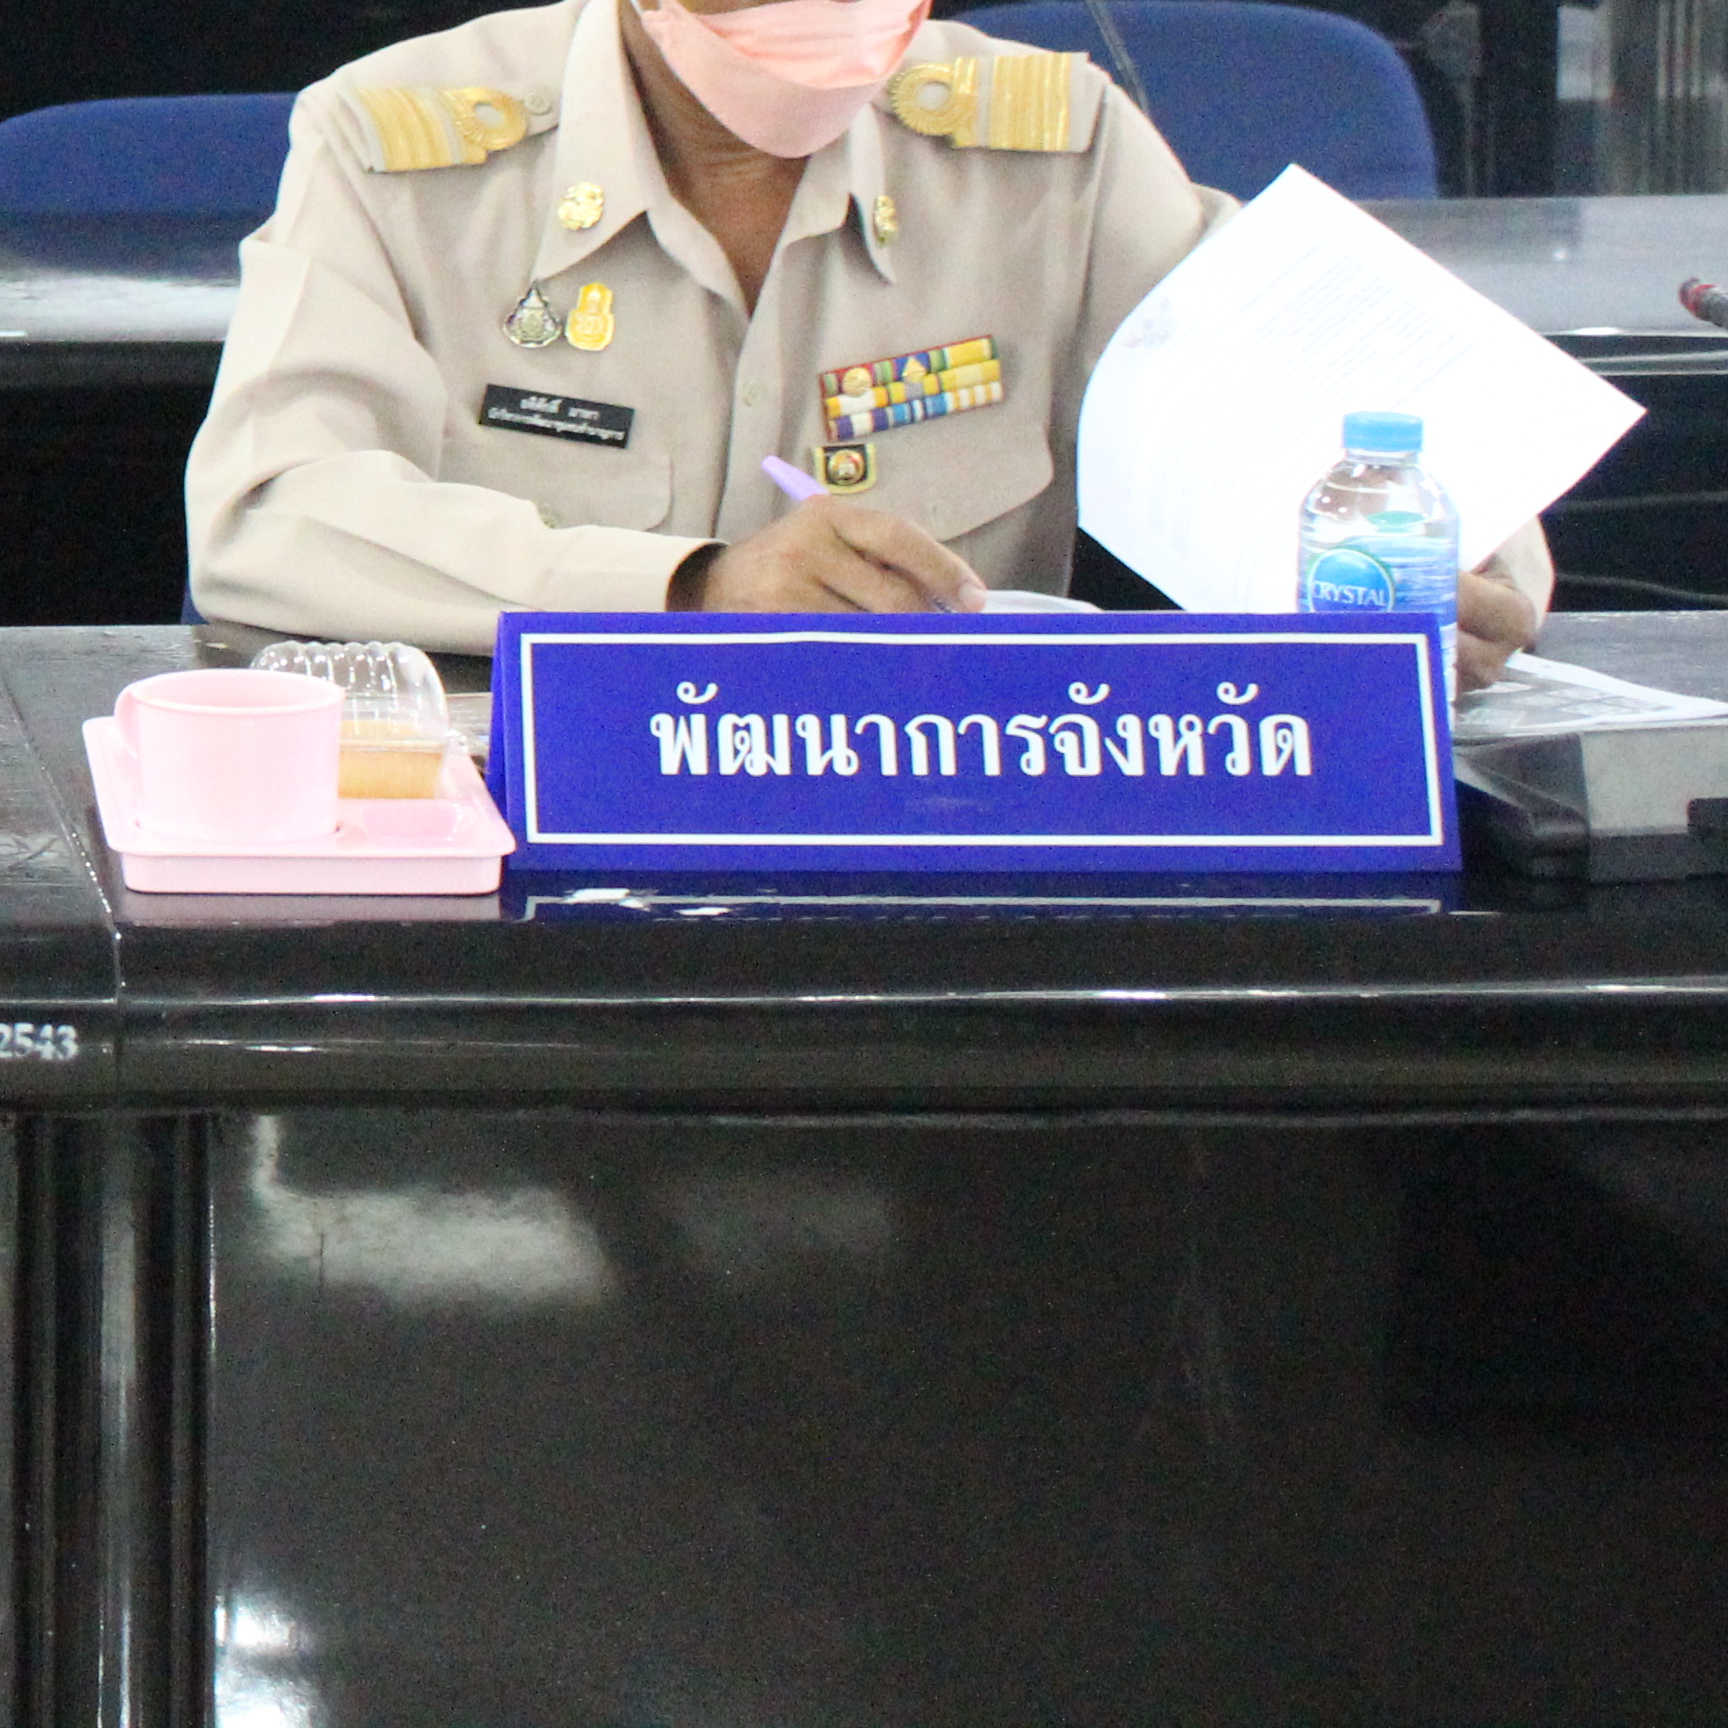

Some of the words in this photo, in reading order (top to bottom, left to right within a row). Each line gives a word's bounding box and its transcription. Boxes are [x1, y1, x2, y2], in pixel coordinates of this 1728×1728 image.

[649, 680, 1313, 778] พัฒนาการจังหวัด
